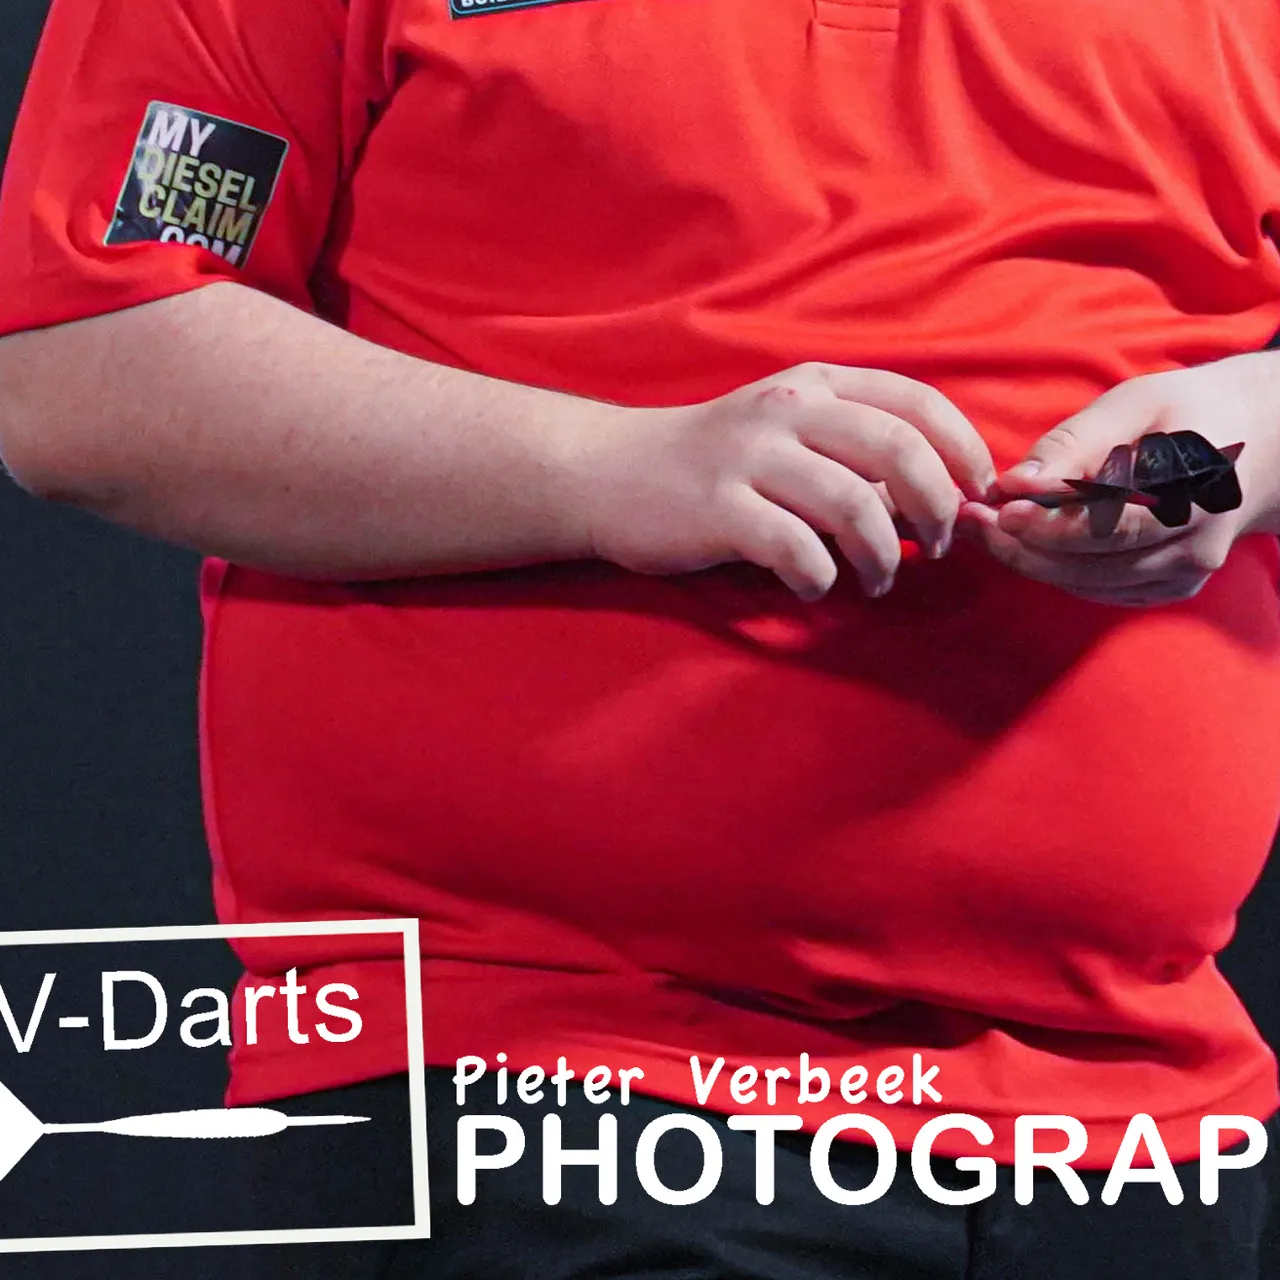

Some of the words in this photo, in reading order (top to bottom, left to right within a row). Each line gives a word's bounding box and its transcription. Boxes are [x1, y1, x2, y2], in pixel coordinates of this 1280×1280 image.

[147, 109, 217, 157] MY
[137, 144, 258, 212] DIESEL
[138, 183, 255, 246] CLAIM
